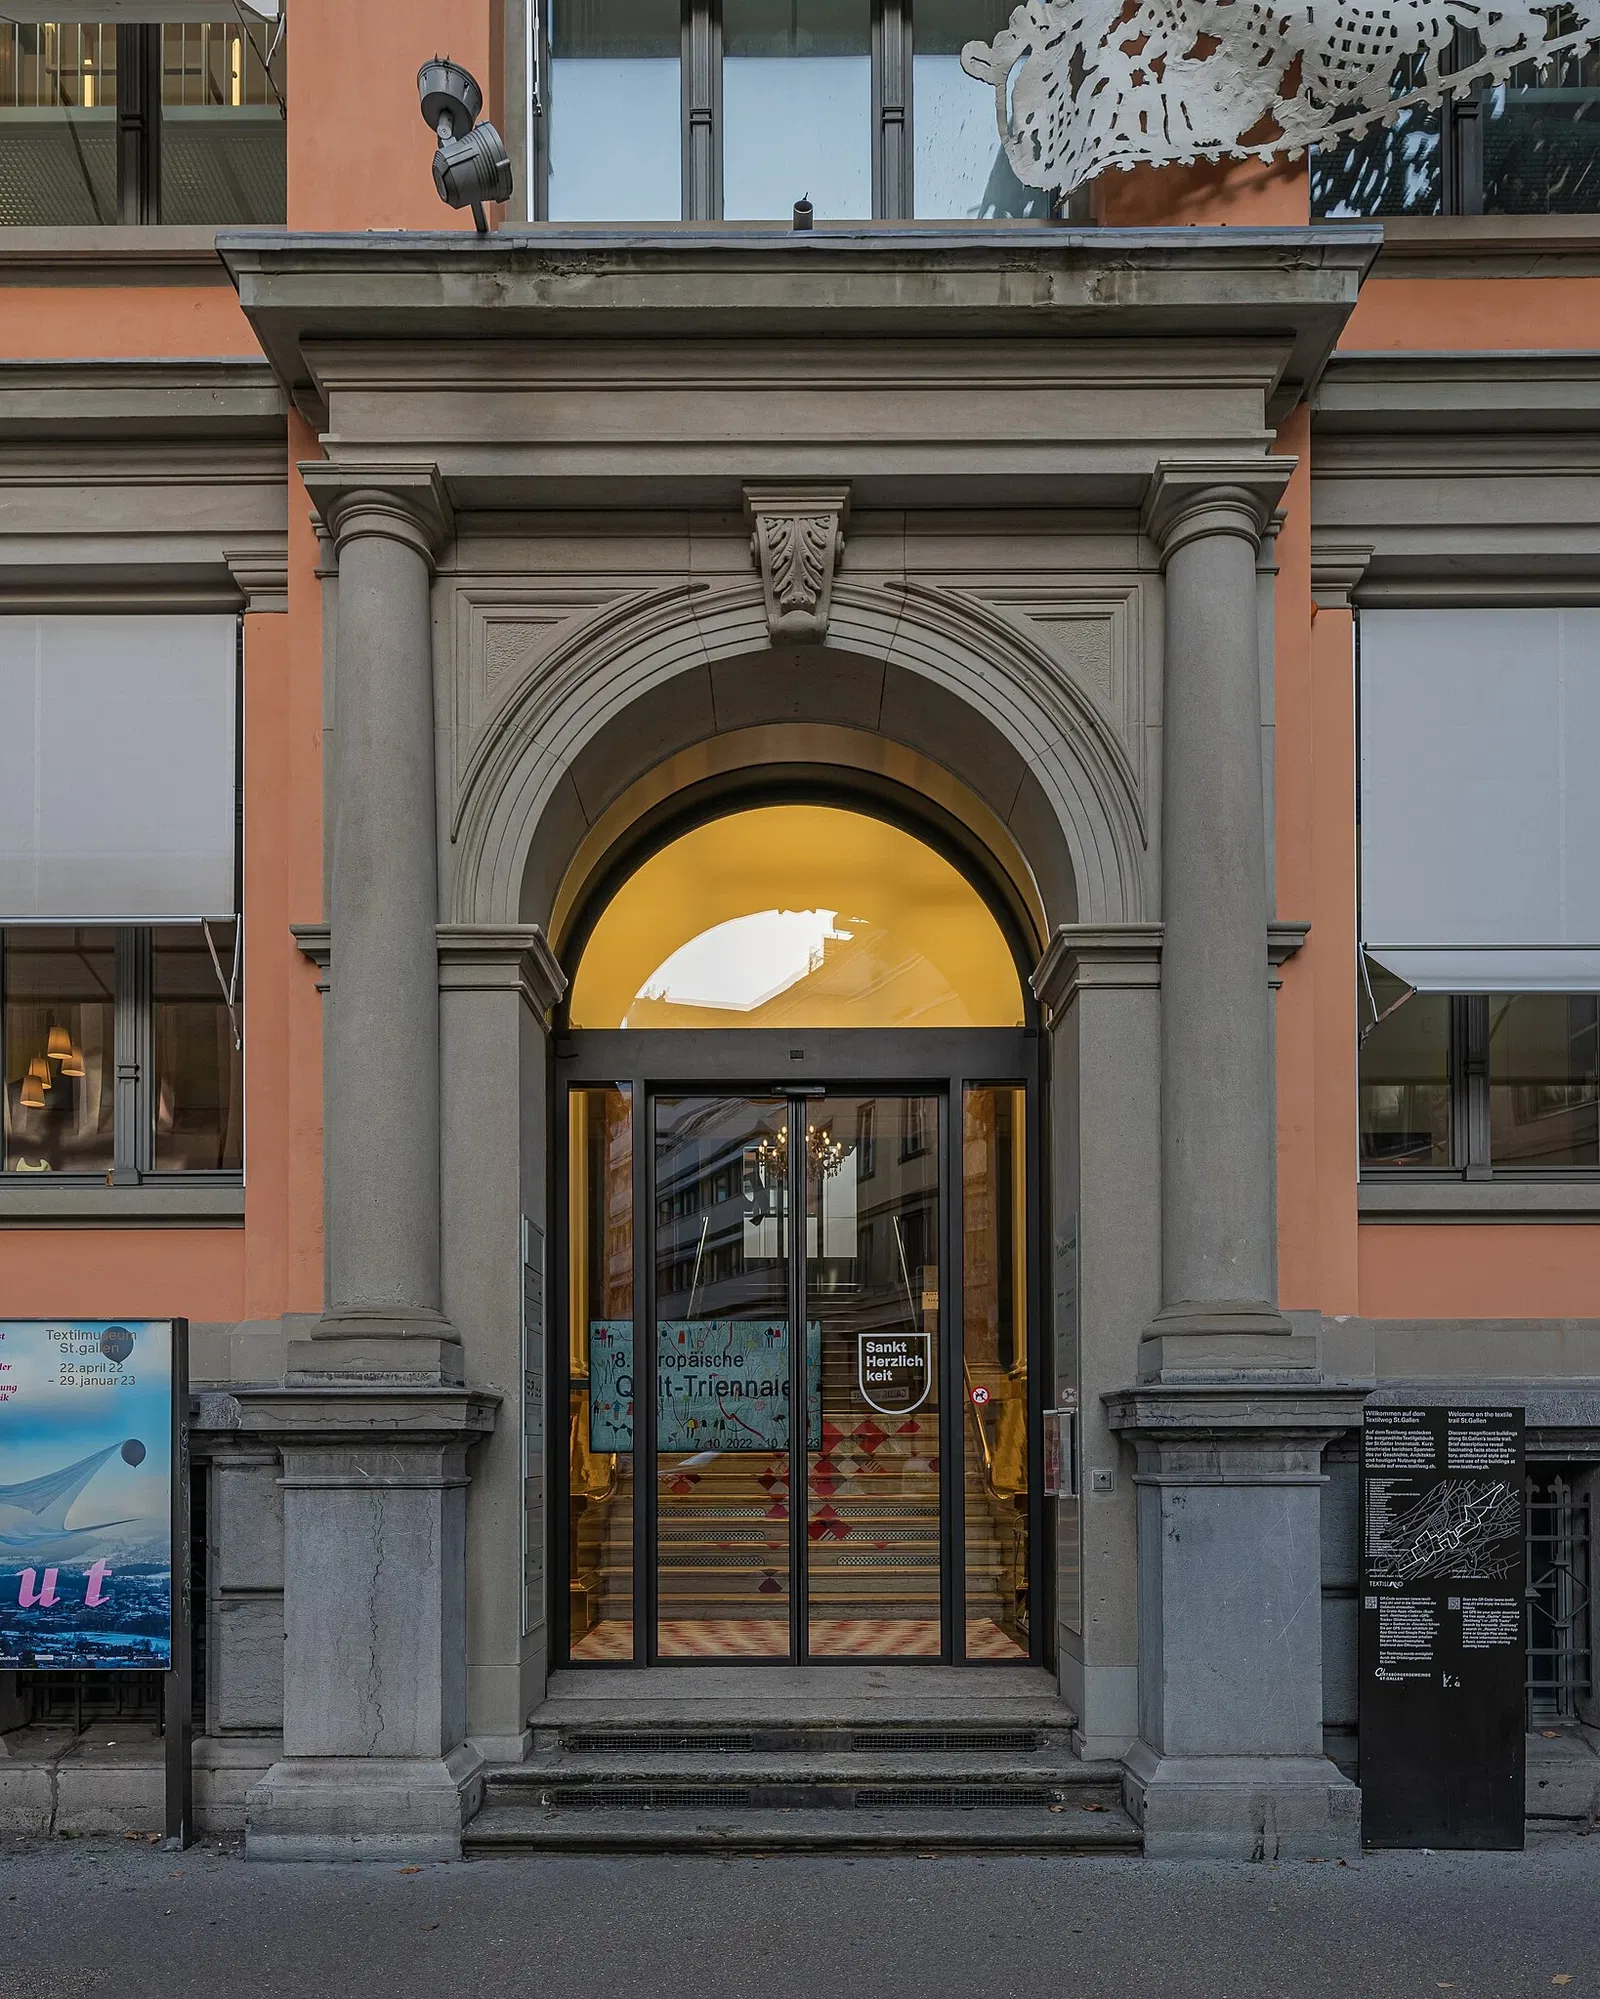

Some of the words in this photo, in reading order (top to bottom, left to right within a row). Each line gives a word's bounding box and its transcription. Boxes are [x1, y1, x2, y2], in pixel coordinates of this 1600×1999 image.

[46, 1330, 136, 1340] Textilmuseum
[866, 1342, 907, 1353] Sankt
[615, 1352, 630, 1368] 8.
[658, 1352, 744, 1372] ropäische
[866, 1356, 923, 1367] Herzlich
[109, 1363, 123, 1372] 22
[121, 1376, 135, 1385] 23
[866, 1370, 893, 1381] keit
[727, 1439, 752, 1448] 2022
